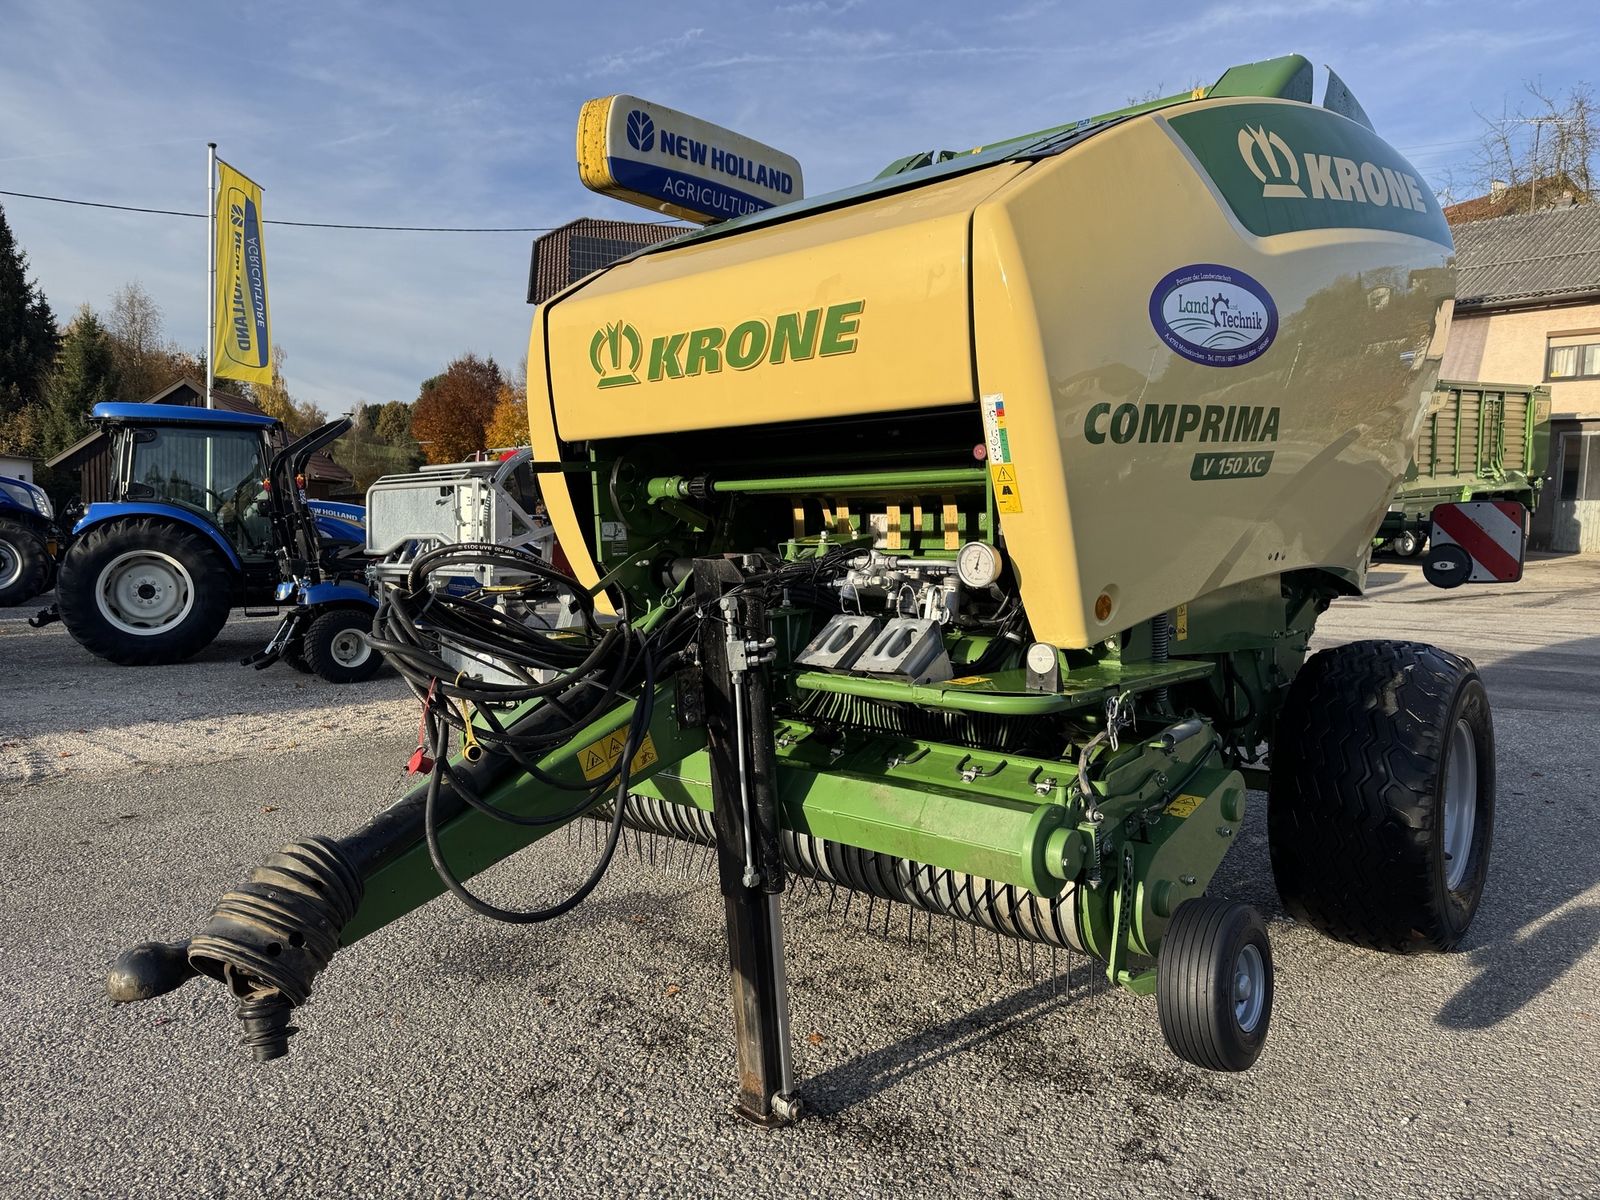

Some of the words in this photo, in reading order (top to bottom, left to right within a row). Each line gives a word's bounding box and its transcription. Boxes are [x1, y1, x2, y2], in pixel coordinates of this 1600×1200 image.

[660, 129, 707, 166] NEW
[711, 147, 793, 195] HOLLAND
[1303, 153, 1427, 214] KRONE
[1178, 294, 1210, 315] Land
[1220, 310, 1263, 330] Technik
[647, 299, 866, 383] KRONE
[1083, 402, 1281, 445] COMPRIMA
[1202, 458, 1215, 476] V
[1218, 457, 1243, 475] 150
[1244, 456, 1266, 474] XC
[322, 508, 358, 521] HOLLAND
